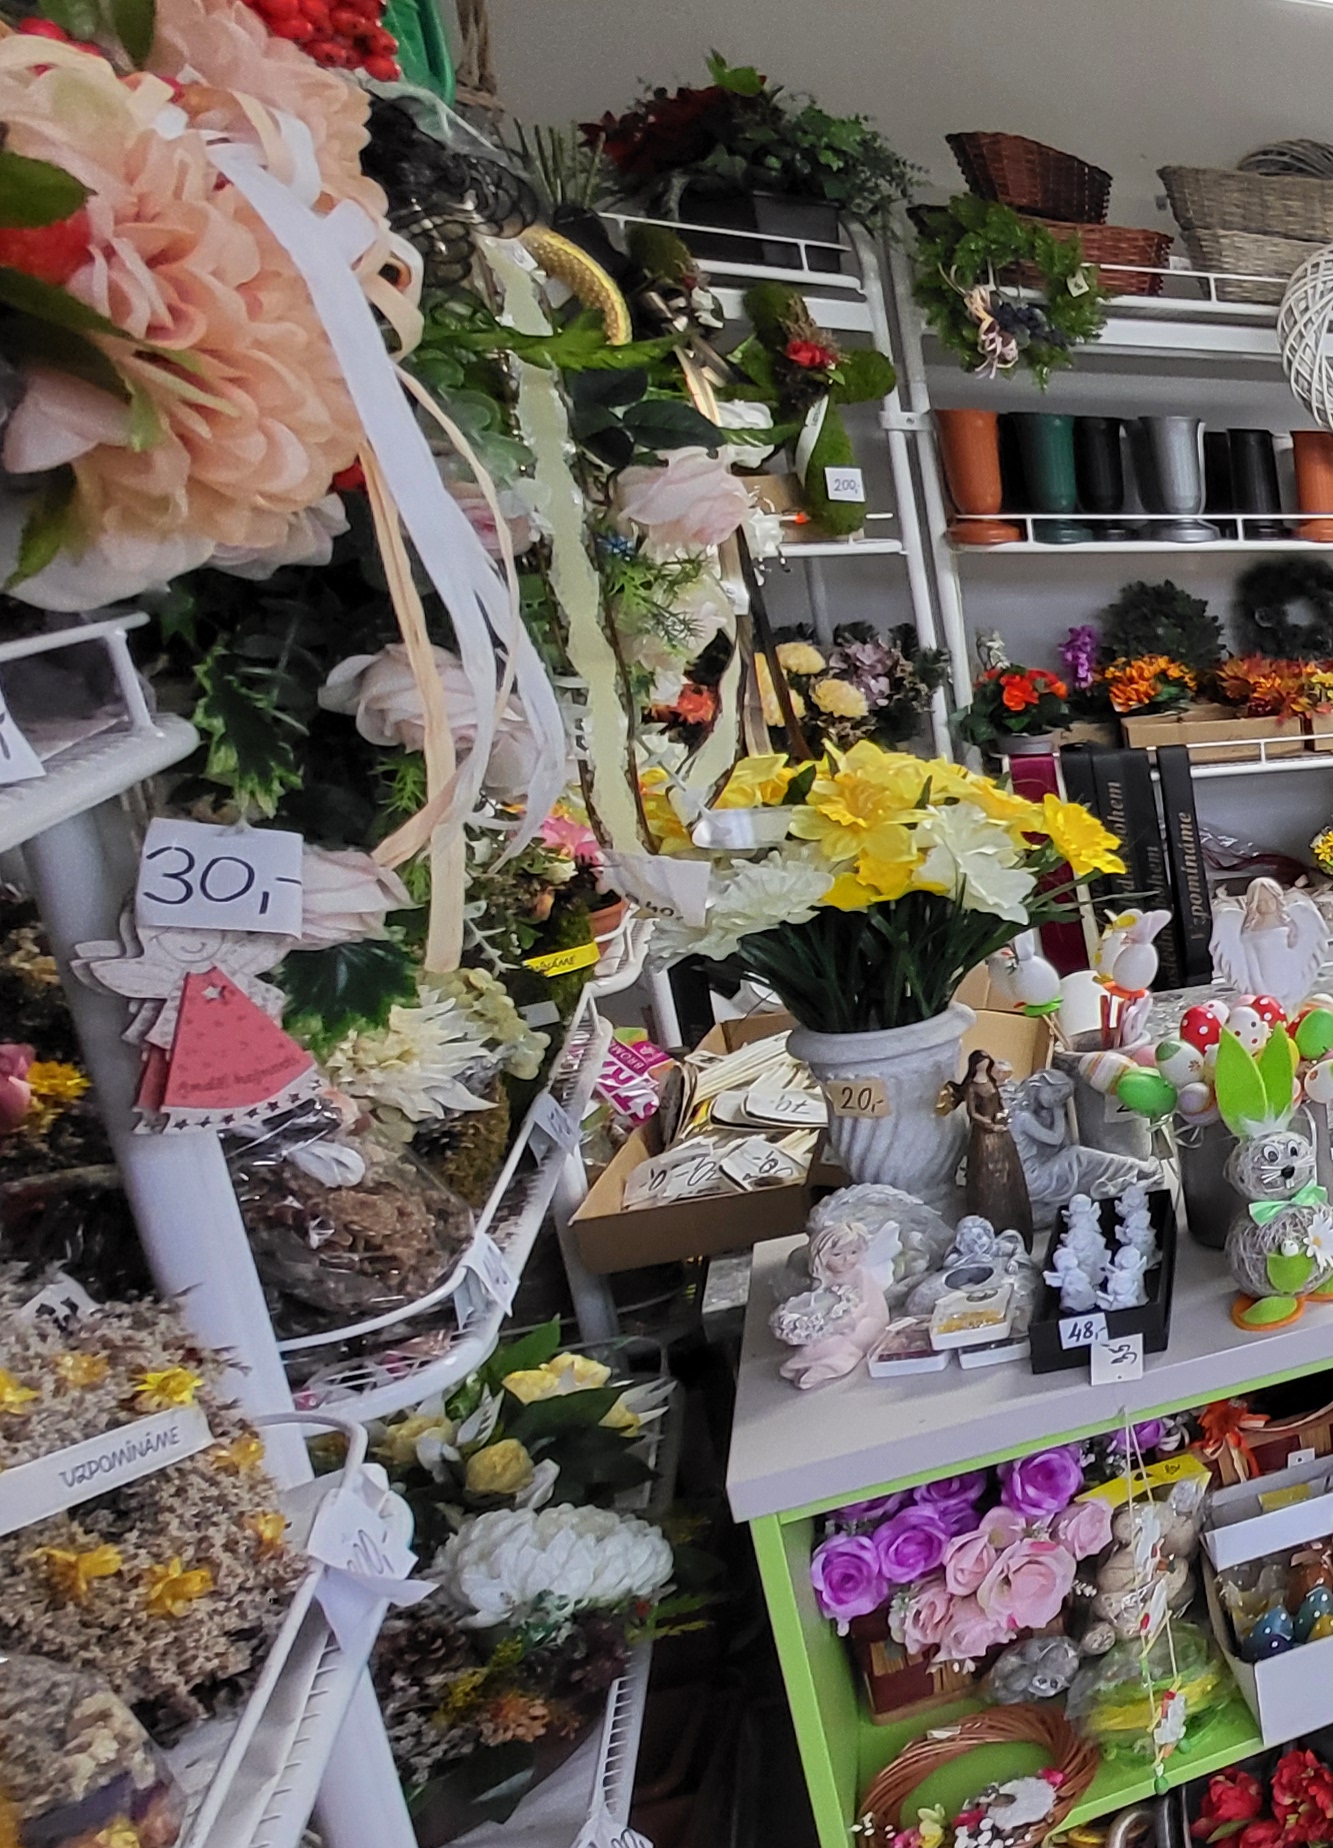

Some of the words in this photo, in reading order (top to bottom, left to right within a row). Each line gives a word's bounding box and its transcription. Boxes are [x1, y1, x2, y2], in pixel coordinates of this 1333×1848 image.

[142, 846, 303, 915] 30,-
[840, 1086, 884, 1113] 20,-
[1067, 1321, 1106, 1342] 48,-
